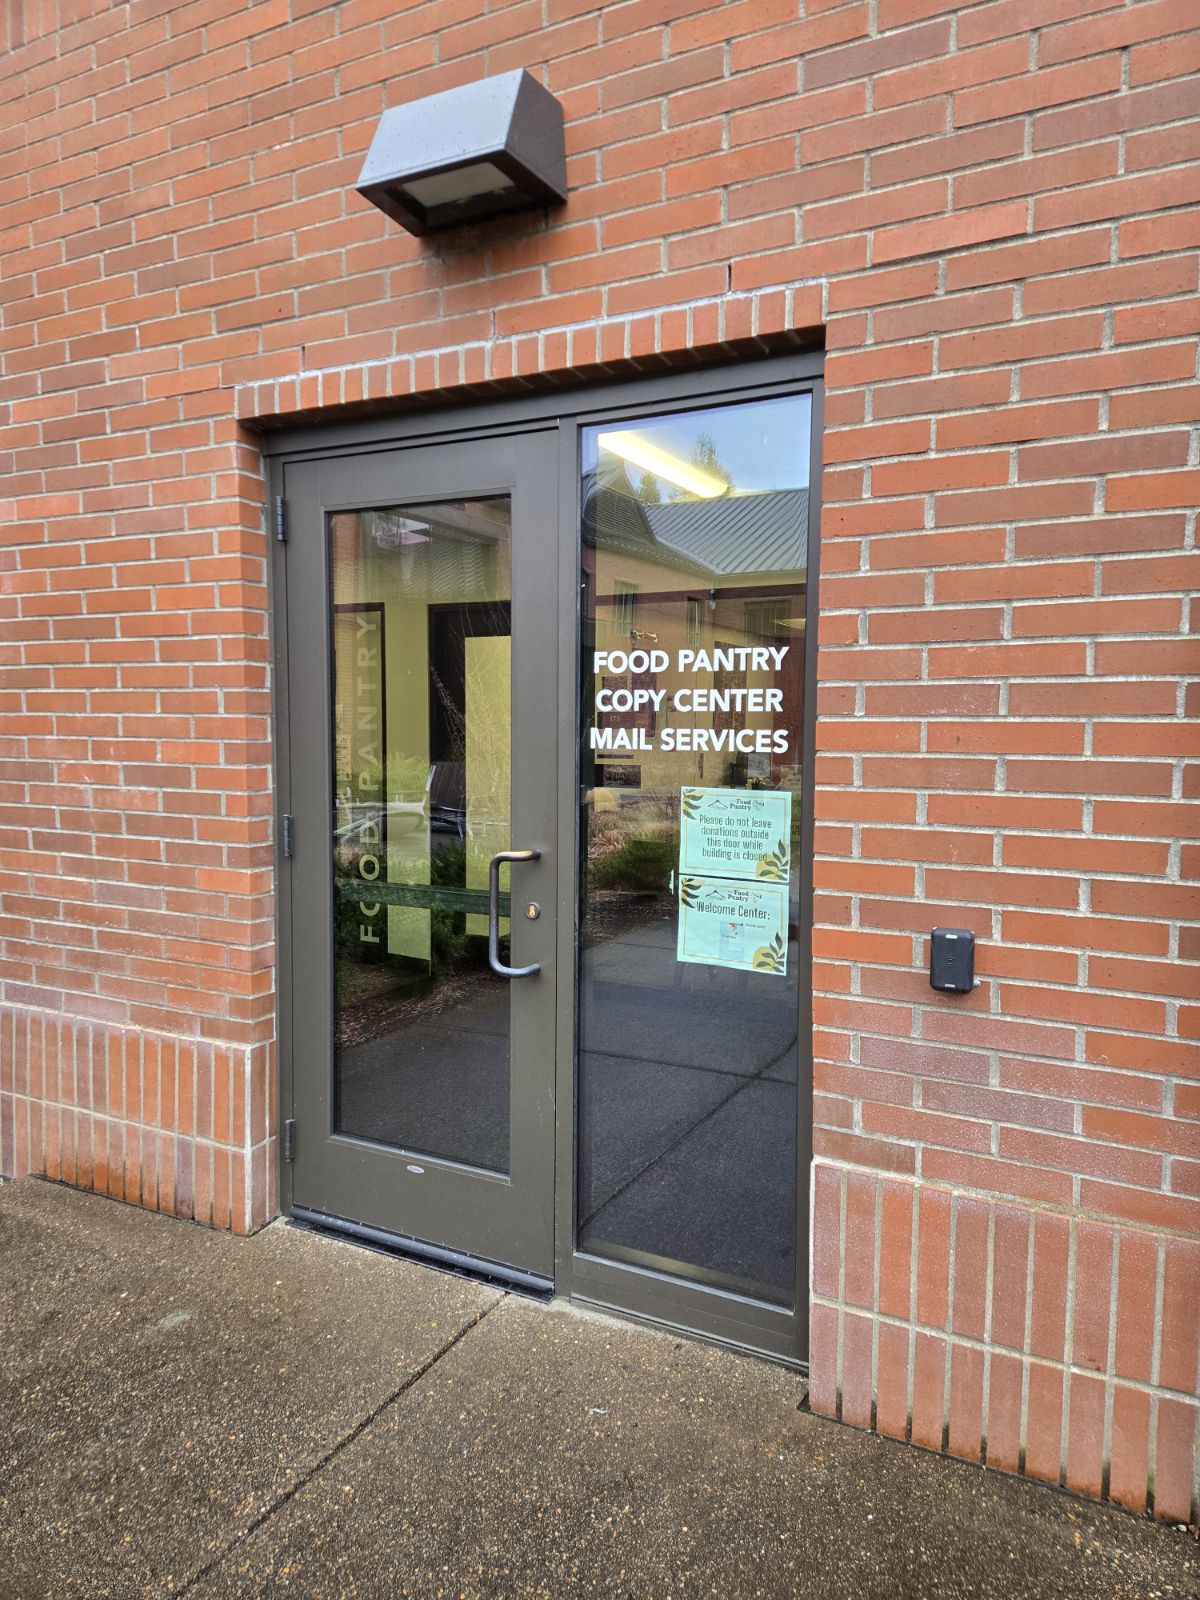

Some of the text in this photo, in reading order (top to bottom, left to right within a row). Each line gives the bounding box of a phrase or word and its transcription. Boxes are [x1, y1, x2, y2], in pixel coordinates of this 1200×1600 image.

[593, 646, 790, 673] FOOD PANTRY
[356, 616, 379, 791] PANTRY
[595, 688, 784, 712] COPY CENTER
[589, 727, 789, 754] MAIL SERVICES
[729, 803, 752, 812] Pantry
[736, 798, 752, 806] Food
[699, 814, 772, 829] Please do not leave
[701, 826, 769, 840] donations outside
[707, 838, 763, 851] this door while
[702, 847, 768, 862] building is closed
[727, 893, 749, 902] Pantry
[734, 889, 749, 897] Food
[696, 901, 771, 921] Welcome Center:
